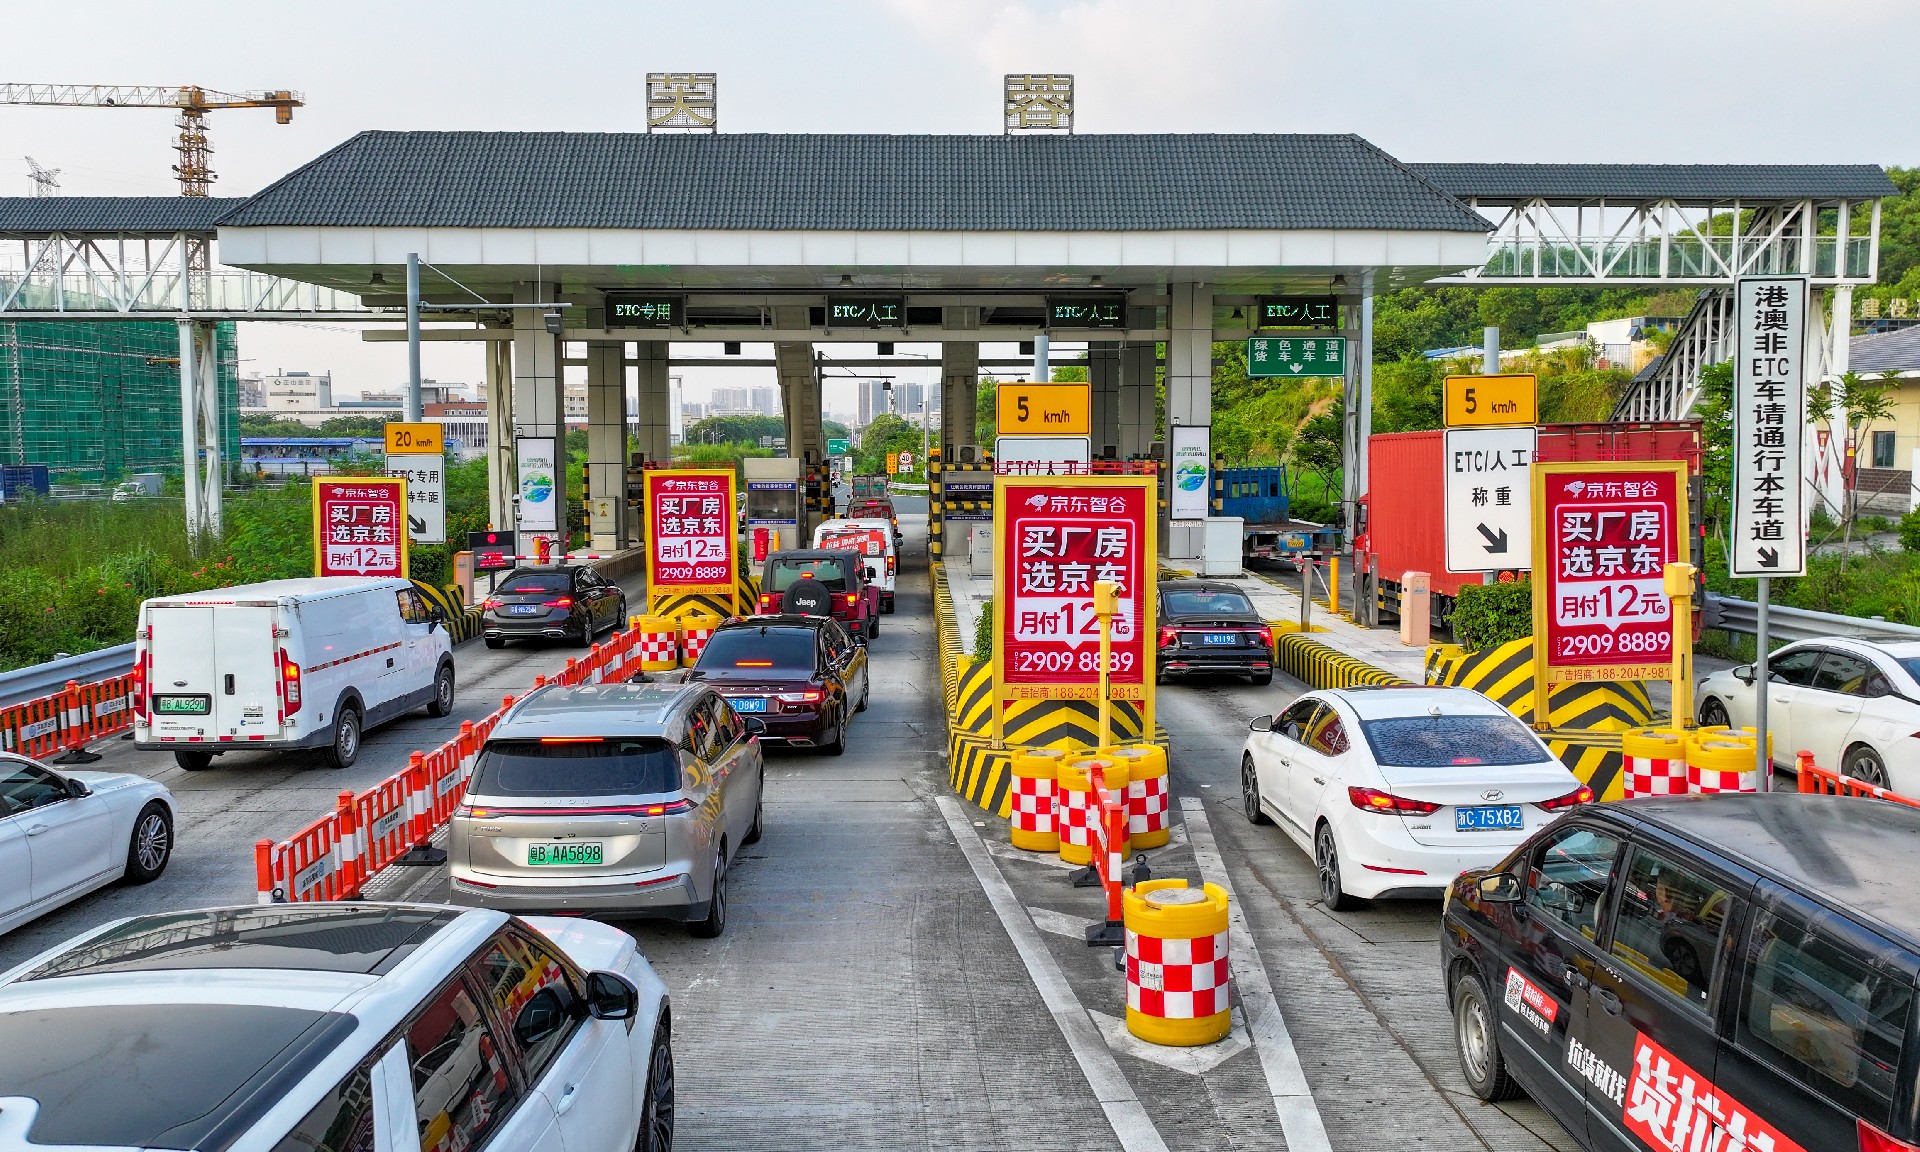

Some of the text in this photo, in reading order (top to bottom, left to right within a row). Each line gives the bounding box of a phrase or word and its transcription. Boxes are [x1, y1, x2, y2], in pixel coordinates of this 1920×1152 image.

[615, 303, 671, 321] ETC专用
[833, 303, 898, 322] ETC/人工
[1055, 304, 1119, 322] ETC/人工
[1266, 303, 1331, 321] ETC/人工
[1861, 298, 1920, 318] 建设
[1018, 396, 1071, 424] 5 km/h
[1465, 388, 1517, 415] 5 km/h
[394, 431, 433, 448] 20 km/h
[1455, 449, 1528, 473] ETC/人工
[1472, 486, 1512, 507] 称重
[1586, 480, 1659, 498] 京东智谷
[661, 497, 721, 515] 买厂房
[1050, 495, 1127, 513] 京东智谷
[330, 505, 391, 524] 买厂房
[330, 525, 392, 543] 选京东
[661, 517, 722, 535] 选京东
[1561, 510, 1661, 543] 买厂房
[1022, 526, 1128, 559] 买厂房
[1561, 544, 1662, 578] 选京东
[662, 568, 693, 579] 2909
[695, 566, 727, 579] 8889
[1021, 560, 1128, 594] 选京东
[796, 598, 817, 607] Jeep
[1562, 631, 1671, 656] 2909 8889
[1019, 651, 1074, 672] 2909
[552, 845, 601, 862] AA5898
[1567, 1036, 1627, 1108] 拉货就找
